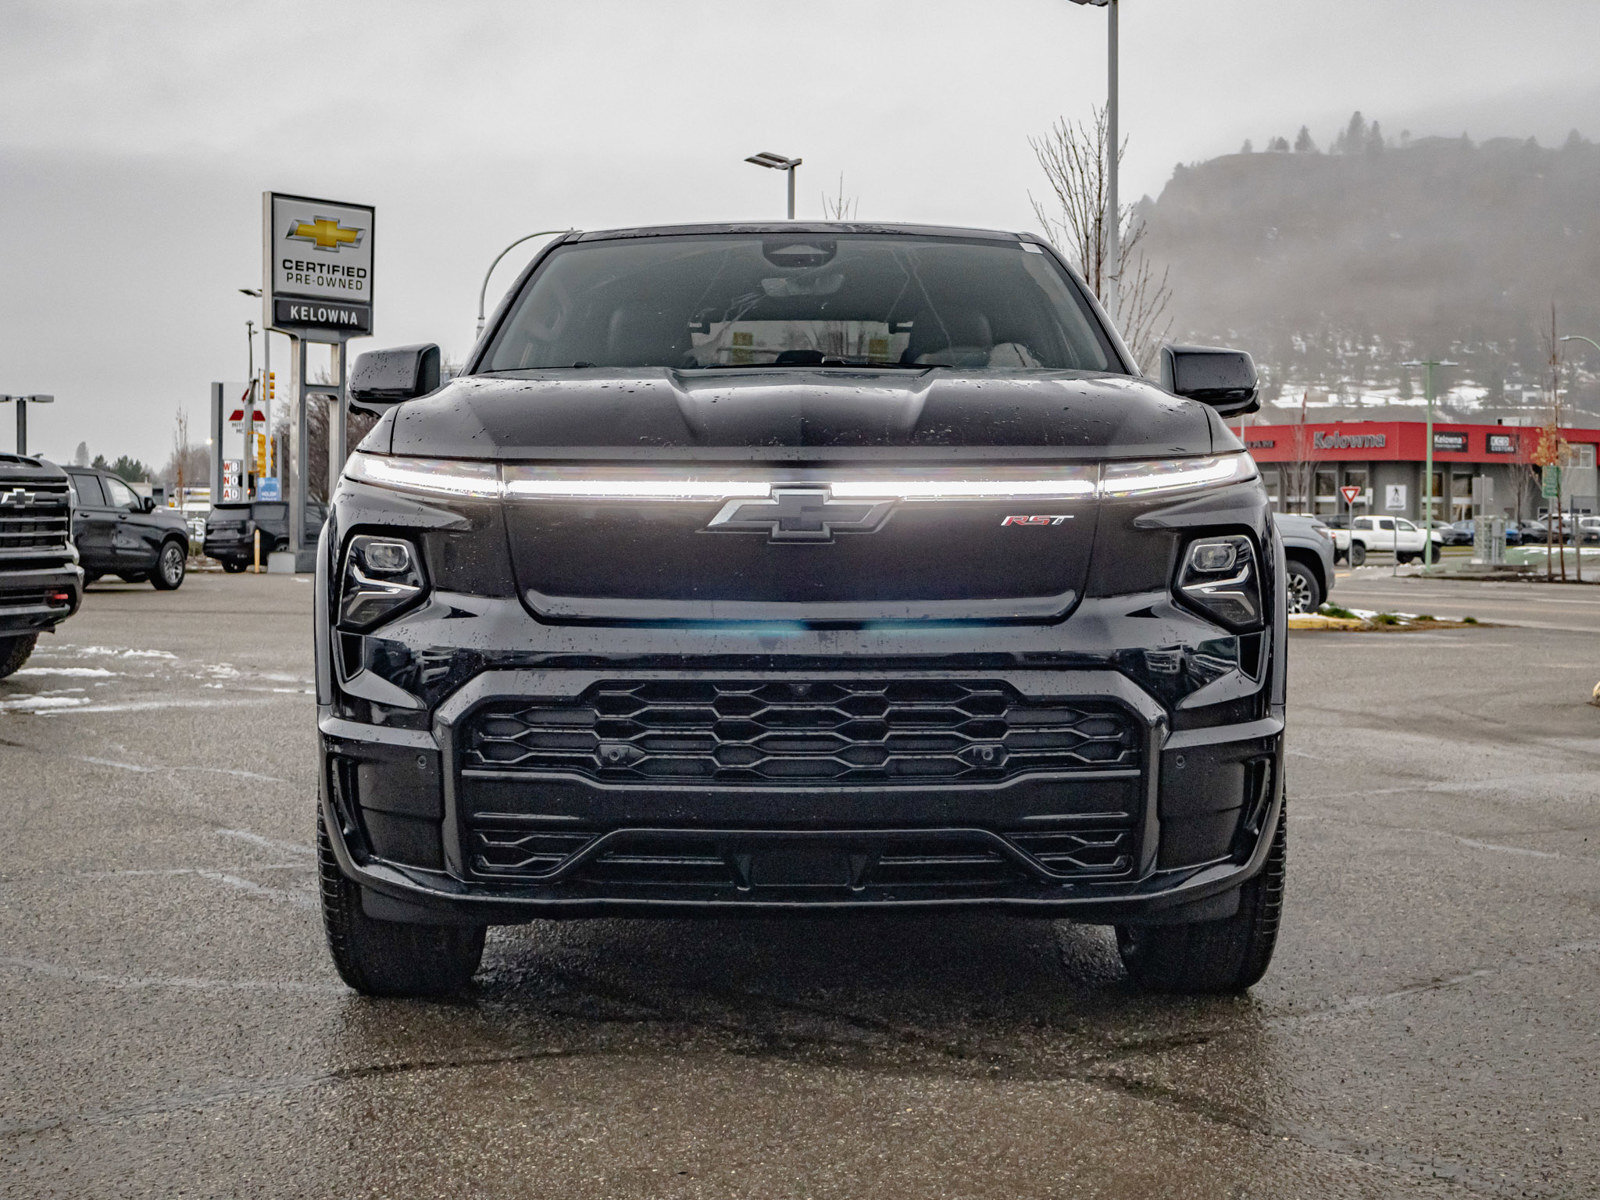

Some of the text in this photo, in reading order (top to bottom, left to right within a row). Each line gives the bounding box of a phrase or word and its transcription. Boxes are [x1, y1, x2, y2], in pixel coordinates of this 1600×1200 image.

[282, 259, 367, 279] CERTIFIED
[286, 272, 363, 291] PRE-OWNED
[290, 305, 358, 325] KELOWNA
[1313, 430, 1386, 449] Kelowna
[1000, 514, 1075, 526] RST
